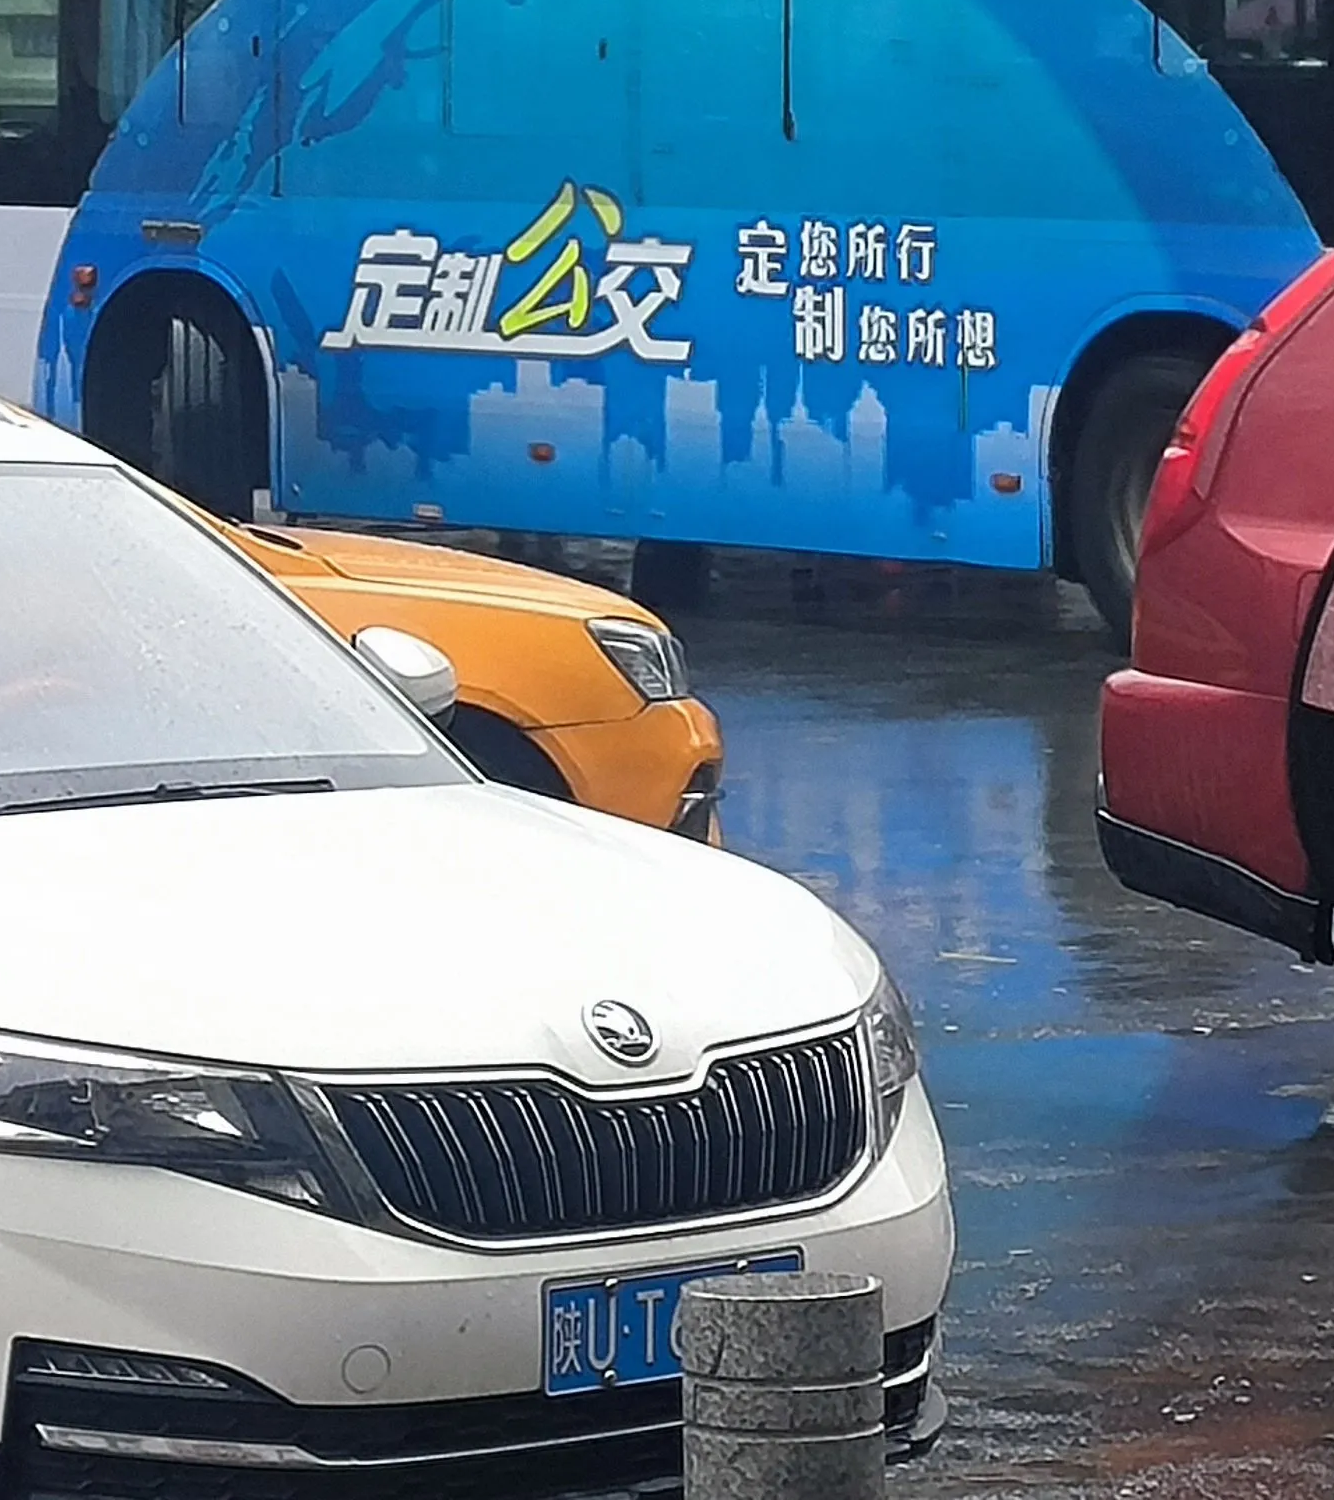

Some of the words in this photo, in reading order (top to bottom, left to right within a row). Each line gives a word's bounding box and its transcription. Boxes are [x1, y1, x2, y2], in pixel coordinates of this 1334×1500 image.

[320, 175, 694, 365] 定制公交
[735, 218, 939, 296] 定您所行
[792, 282, 999, 370] 制您所想
[552, 1288, 685, 1376] 陕U·T
